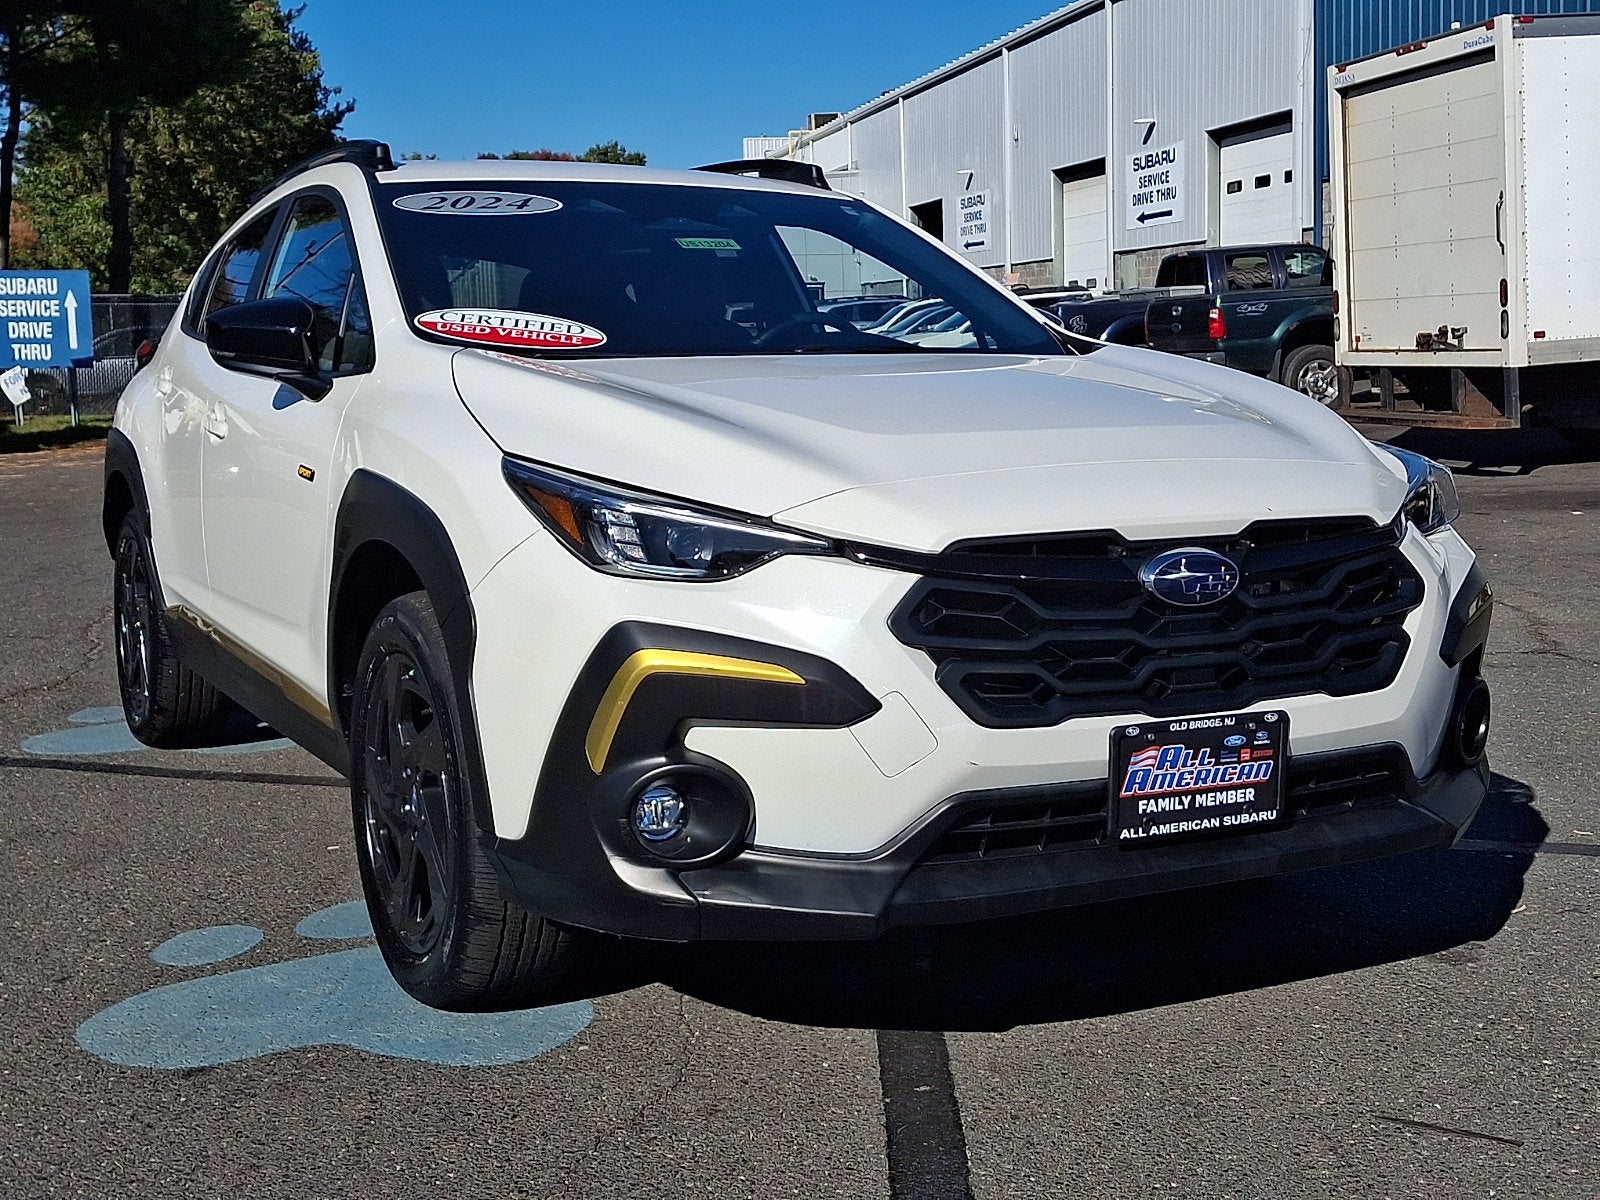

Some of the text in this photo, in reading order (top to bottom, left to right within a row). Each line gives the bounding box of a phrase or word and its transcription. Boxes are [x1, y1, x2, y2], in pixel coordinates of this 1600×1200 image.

[1463, 34, 1494, 49] DuraCube
[1132, 147, 1176, 173] SUBARU
[1138, 170, 1170, 189] SERVICE
[421, 195, 532, 210] 2024
[960, 193, 986, 210] SUBARU
[1132, 185, 1177, 207] DRIVE THRU
[963, 209, 983, 223] SERVICE
[960, 222, 987, 237] DRIVE THRU
[0, 277, 58, 296] SUBARU
[0, 299, 61, 318] SERVICE
[7, 321, 53, 340] DRIVE
[439, 311, 586, 335] CERTIFIED
[436, 322, 584, 345] USED VEHICLE
[10, 343, 52, 361] THRU
[1169, 722, 1188, 732] OLD
[1224, 717, 1236, 726] NJ
[1138, 788, 1255, 815] FAMILY MEMBER
[1119, 809, 1277, 840] ALL AMERICAN SUBARU
